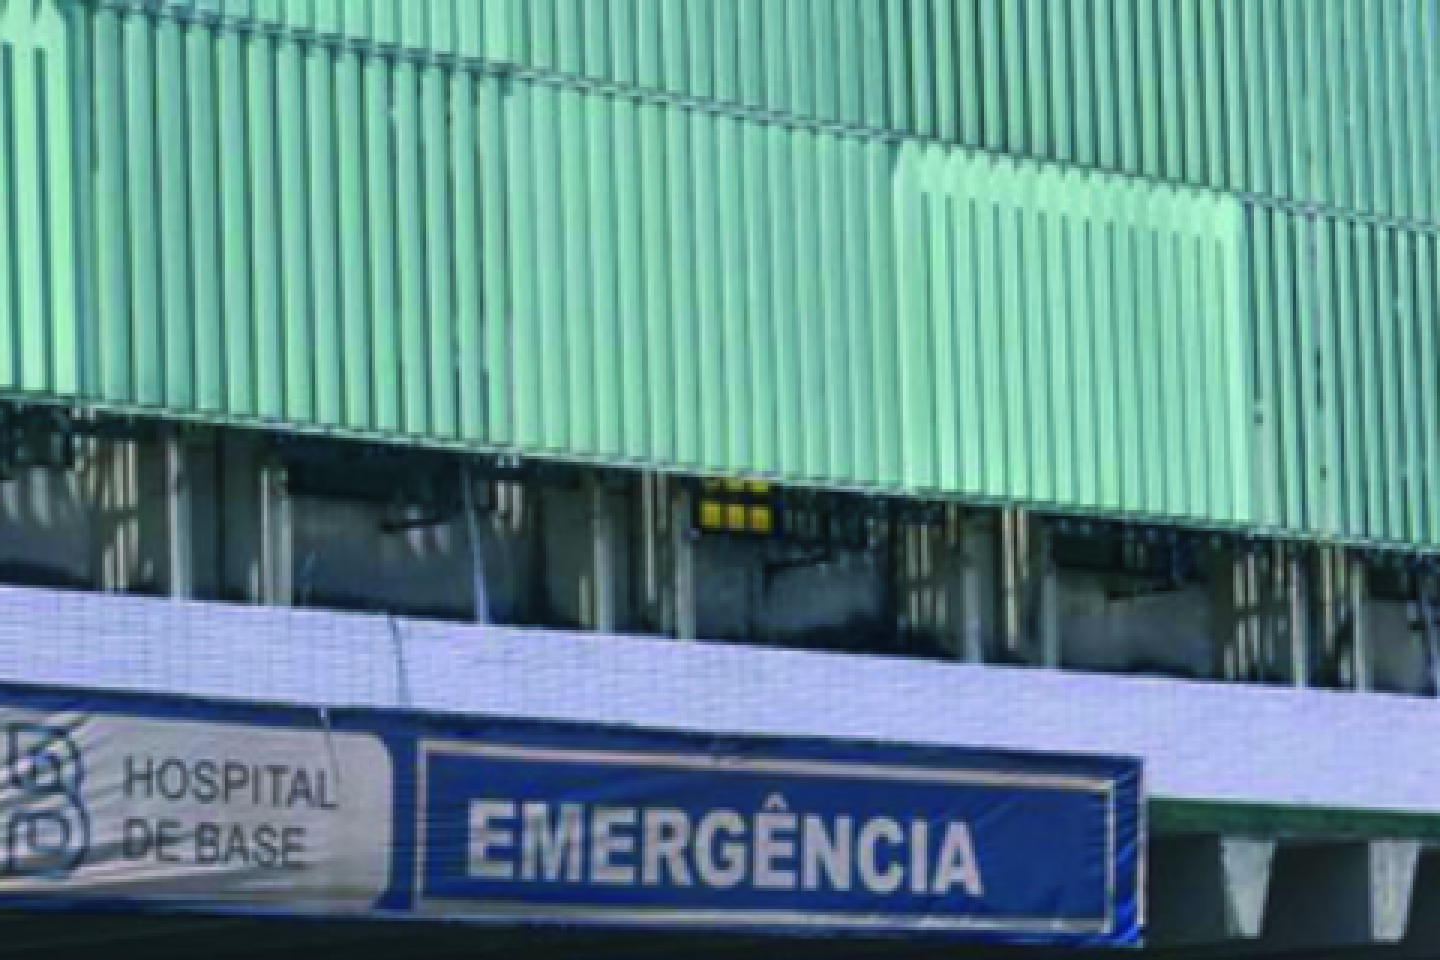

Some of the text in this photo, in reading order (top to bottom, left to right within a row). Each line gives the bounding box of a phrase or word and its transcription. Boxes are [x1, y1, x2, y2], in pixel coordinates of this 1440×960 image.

[122, 755, 339, 811] HOSPITAL
[122, 817, 308, 870] DE BASE
[466, 793, 984, 896] EMERGÊNCIA
